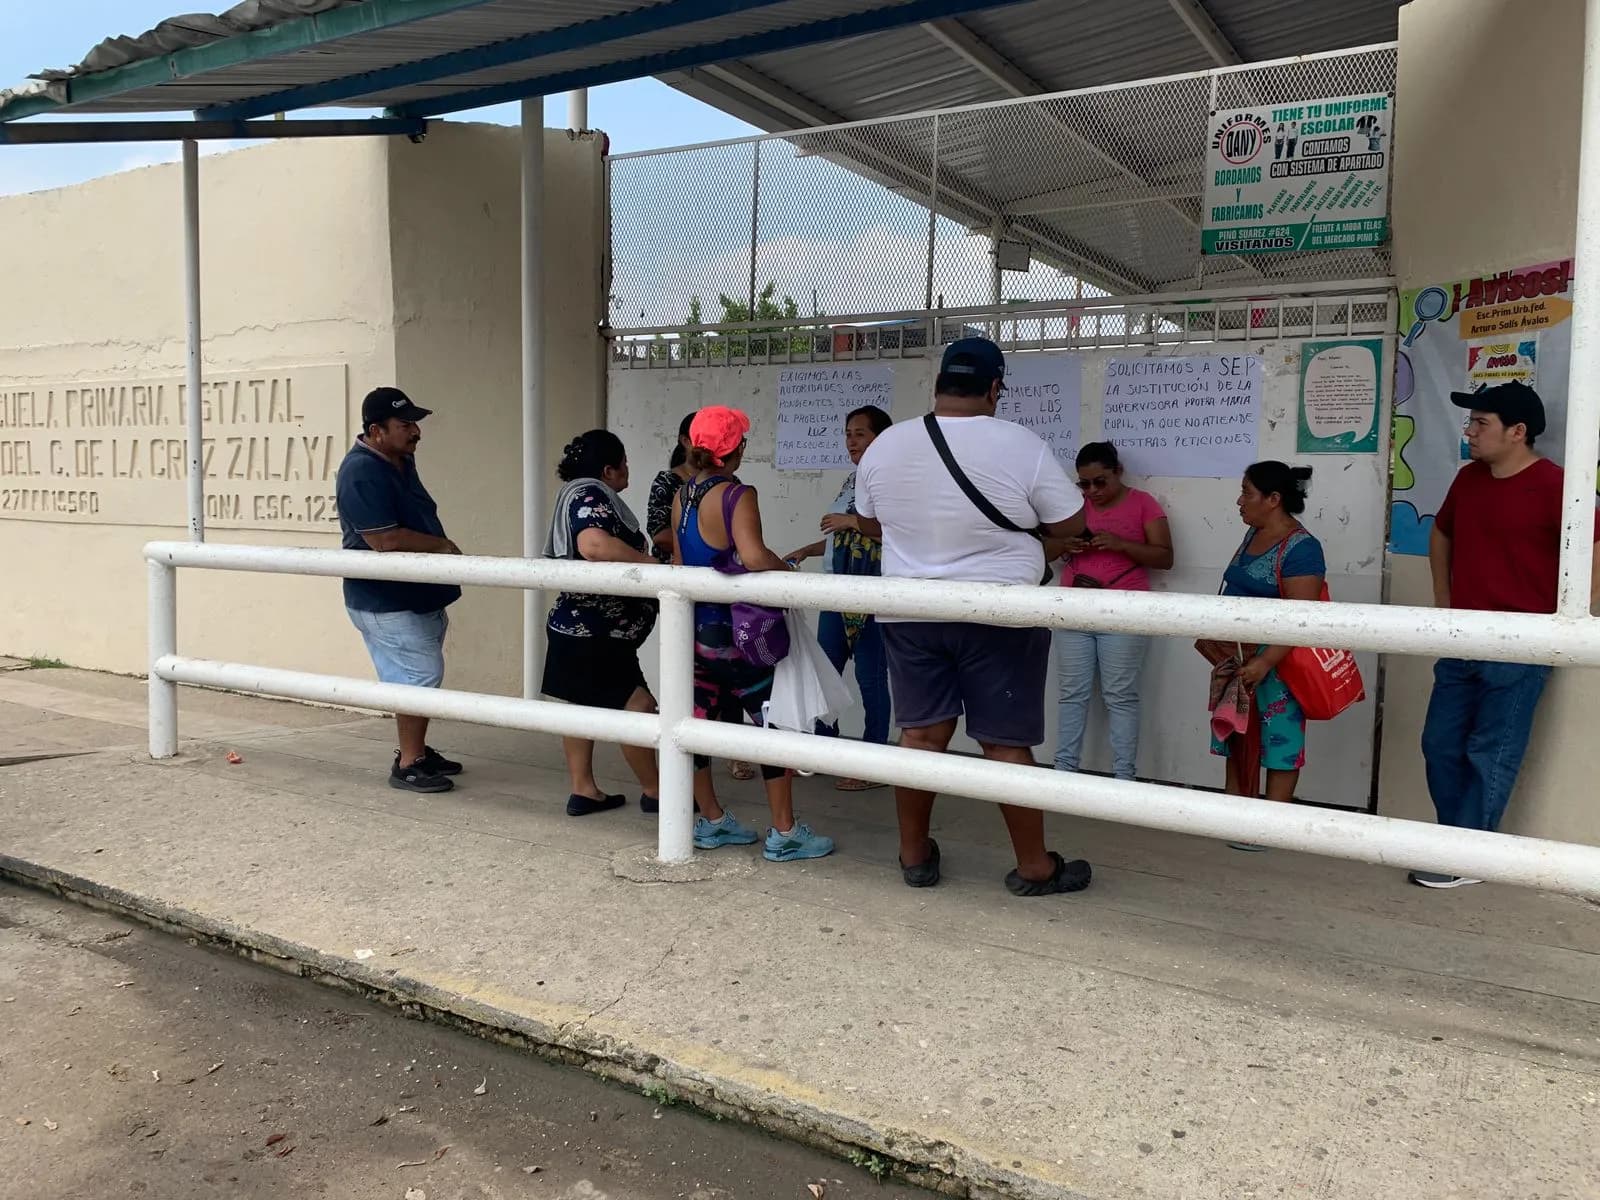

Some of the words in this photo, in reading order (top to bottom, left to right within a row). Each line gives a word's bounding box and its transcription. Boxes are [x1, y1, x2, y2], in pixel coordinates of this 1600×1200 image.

[1272, 106, 1303, 123] TIENE
[1306, 104, 1322, 118] TU
[1325, 96, 1388, 116] UNIFORME
[1212, 113, 1271, 150] UNIFORMES
[1301, 118, 1355, 135] ESCOLAR
[1226, 129, 1257, 158] DANY
[1303, 138, 1349, 156] CONTAMOS
[1271, 162, 1288, 177] CON
[1290, 159, 1325, 175] SISTEMA
[1327, 157, 1338, 172] DE
[1340, 154, 1383, 171] APARTADO
[1215, 167, 1262, 186] BORDAMOS
[1236, 188, 1242, 202] Y
[1211, 204, 1264, 222] FABRICAMOS
[1218, 229, 1237, 240] PINO
[1324, 234, 1355, 244] MERCADO
[1215, 238, 1294, 251] VISITANOS
[1471, 322, 1497, 334] Arturo
[1498, 318, 1518, 330] Solís
[1521, 314, 1549, 327] Ávalos
[1107, 361, 1194, 377] SOLICITAMOS
[1203, 362, 1212, 374] A
[1219, 356, 1257, 376] SEP
[780, 370, 828, 381] EXIGIMOS
[780, 383, 844, 396] AUTORIDADES
[1000, 383, 1060, 398] IMIENTO
[1105, 384, 1121, 396] LA
[1126, 377, 1209, 396] SUSTITUCIÓN
[1218, 380, 1233, 392] DE
[1237, 379, 1252, 391] LA
[0, 391, 58, 428] UELA
[65, 385, 169, 428] PRIMARIA
[840, 395, 889, 408] SOLUCIÓN
[1040, 399, 1062, 413] LOS
[1105, 398, 1179, 414] SUPERVISORA
[778, 413, 789, 423] AL
[793, 413, 839, 424] PROBLEMA
[1142, 418, 1154, 429] YA
[1159, 417, 1180, 429] QUE
[1185, 417, 1200, 428] NO
[1202, 412, 1255, 426] ATIENDE
[808, 427, 828, 437] LUZ
[1060, 430, 1072, 440] LA
[1, 440, 41, 476] DEL
[112, 439, 143, 479] LA
[150, 438, 216, 480] CRZ
[207, 494, 244, 520] ONA
